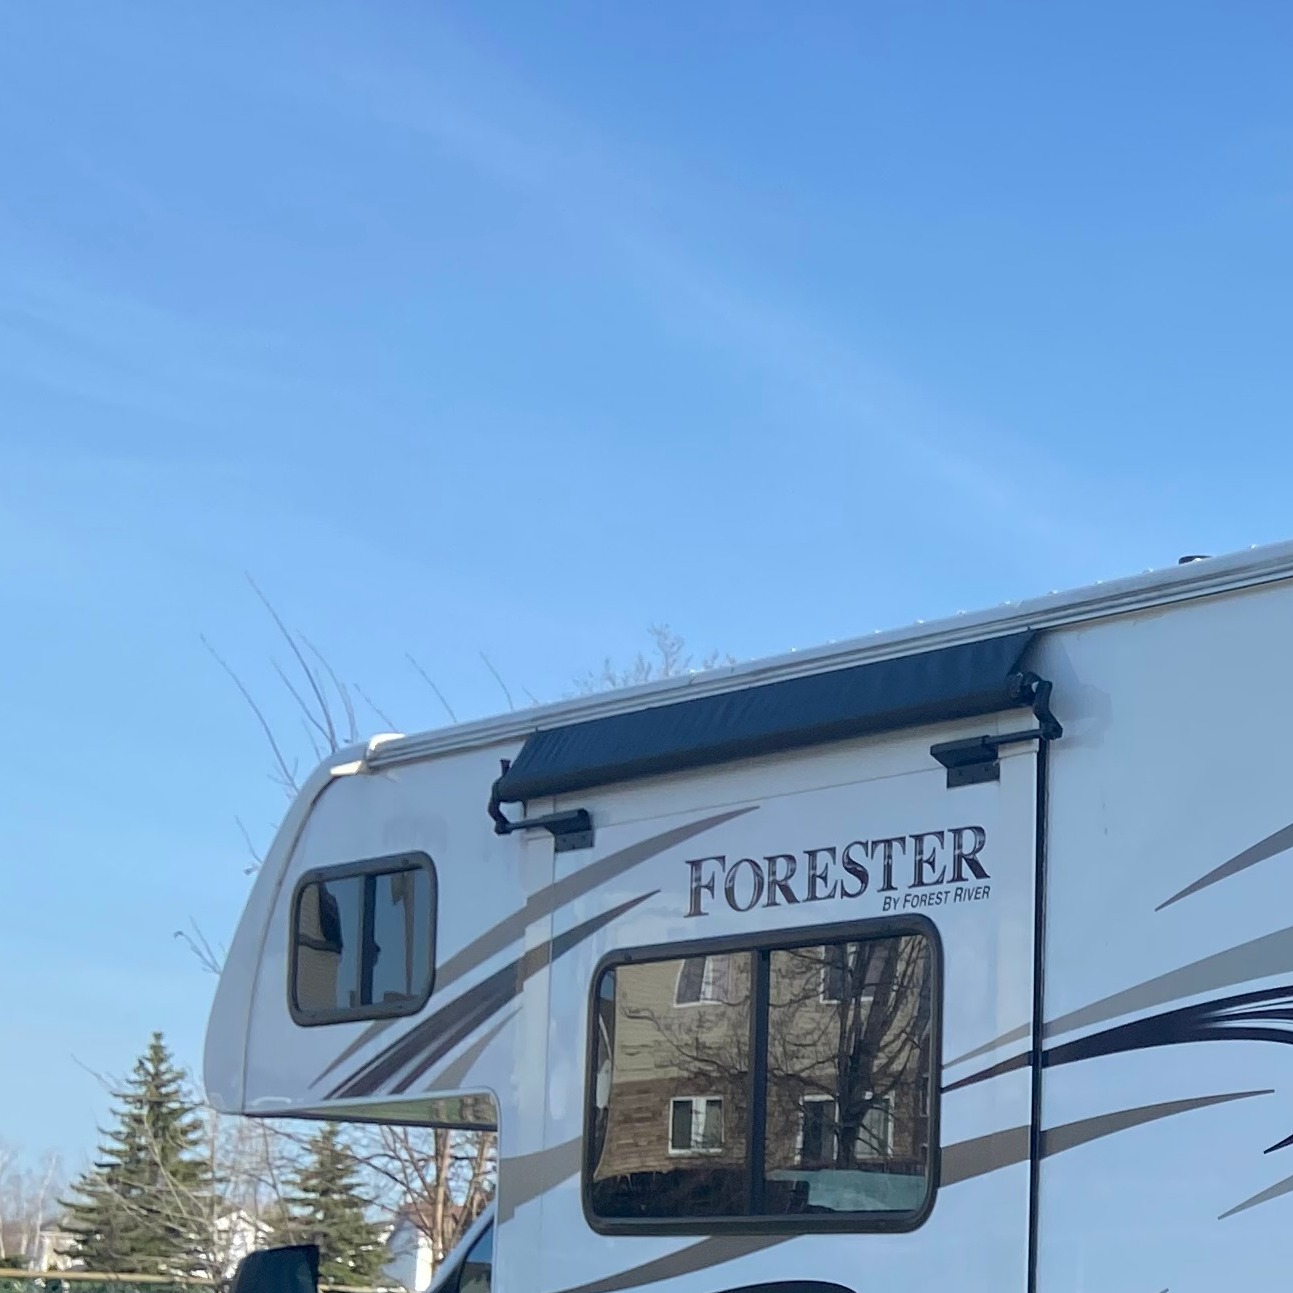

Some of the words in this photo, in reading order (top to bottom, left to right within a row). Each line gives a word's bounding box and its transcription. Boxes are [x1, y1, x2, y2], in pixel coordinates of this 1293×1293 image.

[683, 826, 991, 918] FORESTER
[882, 896, 900, 911] BY
[902, 890, 950, 909] FOREST
[953, 885, 991, 903] RIVER
